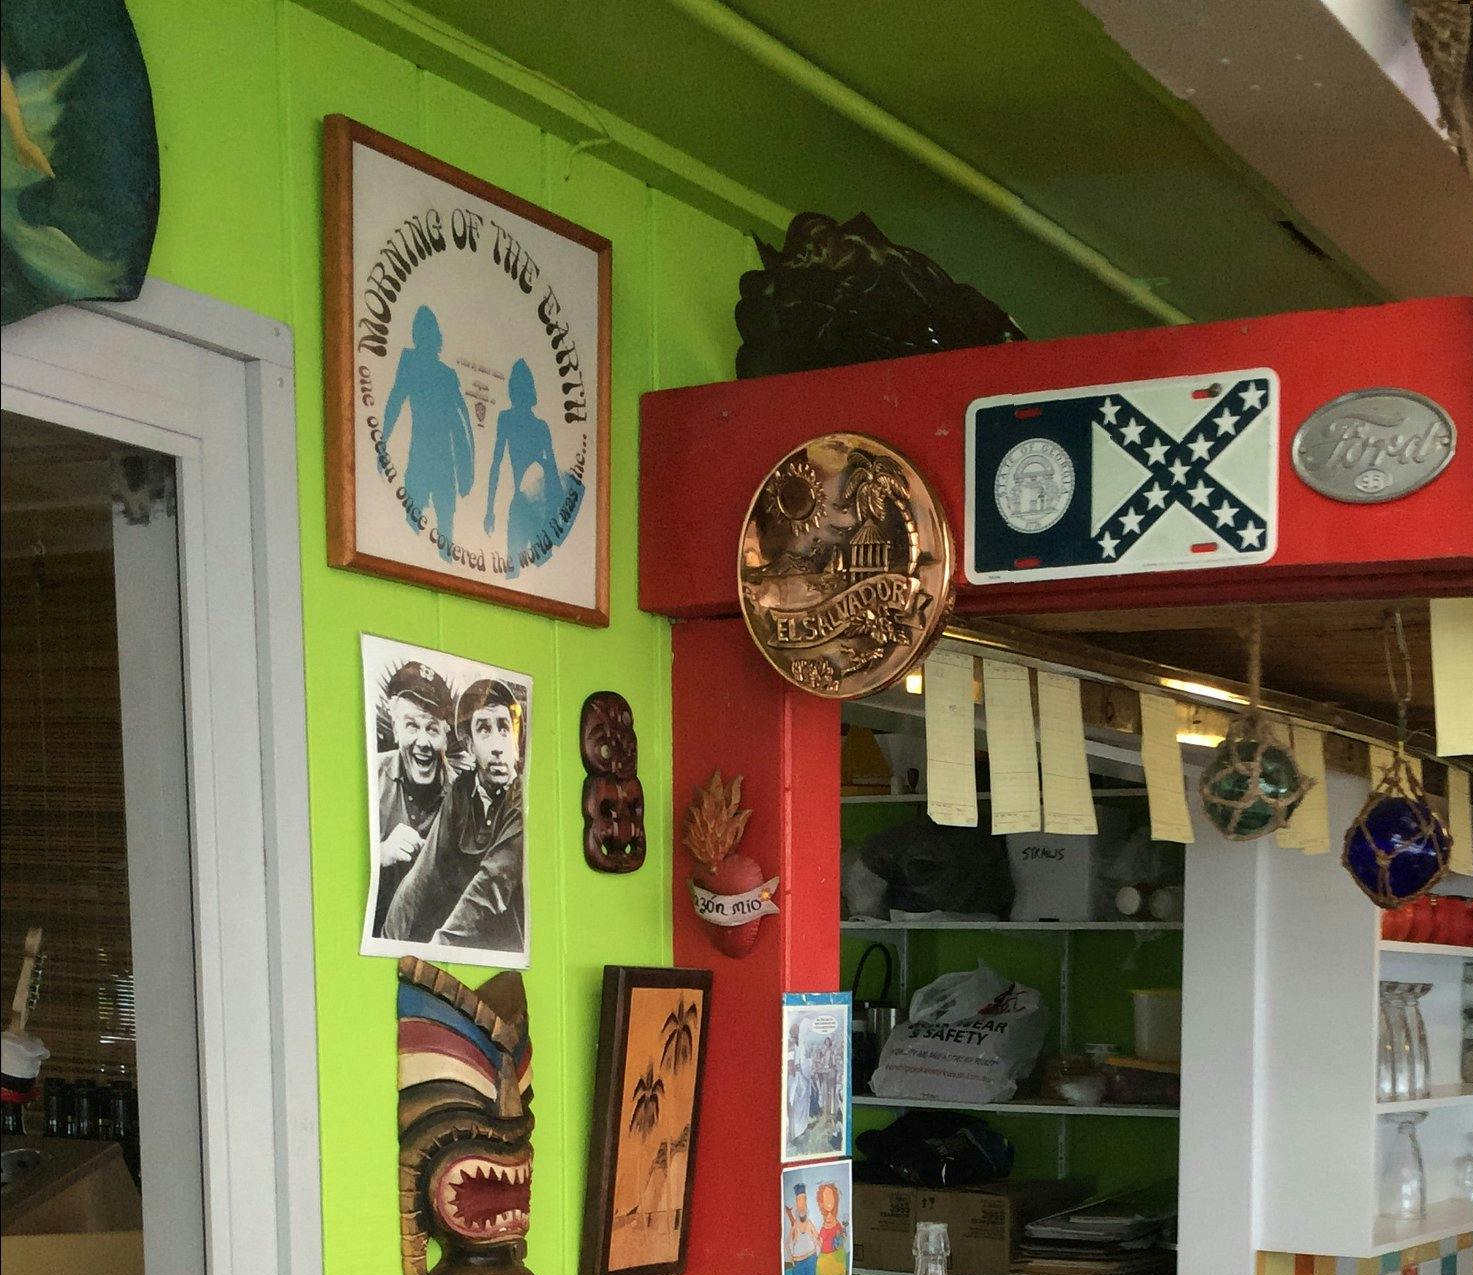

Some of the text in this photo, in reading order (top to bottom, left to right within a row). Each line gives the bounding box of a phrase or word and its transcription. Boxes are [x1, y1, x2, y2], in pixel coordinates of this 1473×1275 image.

[358, 208, 588, 425] MORNING OF THE EARTH
[1318, 413, 1444, 469] Ford
[358, 365, 374, 408] one
[366, 415, 398, 484] ocean
[395, 486, 428, 531] once
[428, 527, 486, 572] covered
[491, 553, 515, 574] the
[1020, 444, 1035, 454] OF
[1041, 444, 1073, 495] GEORGIA
[1021, 846, 1066, 861] STRAWS
[922, 1028, 990, 1046] SAFETY
